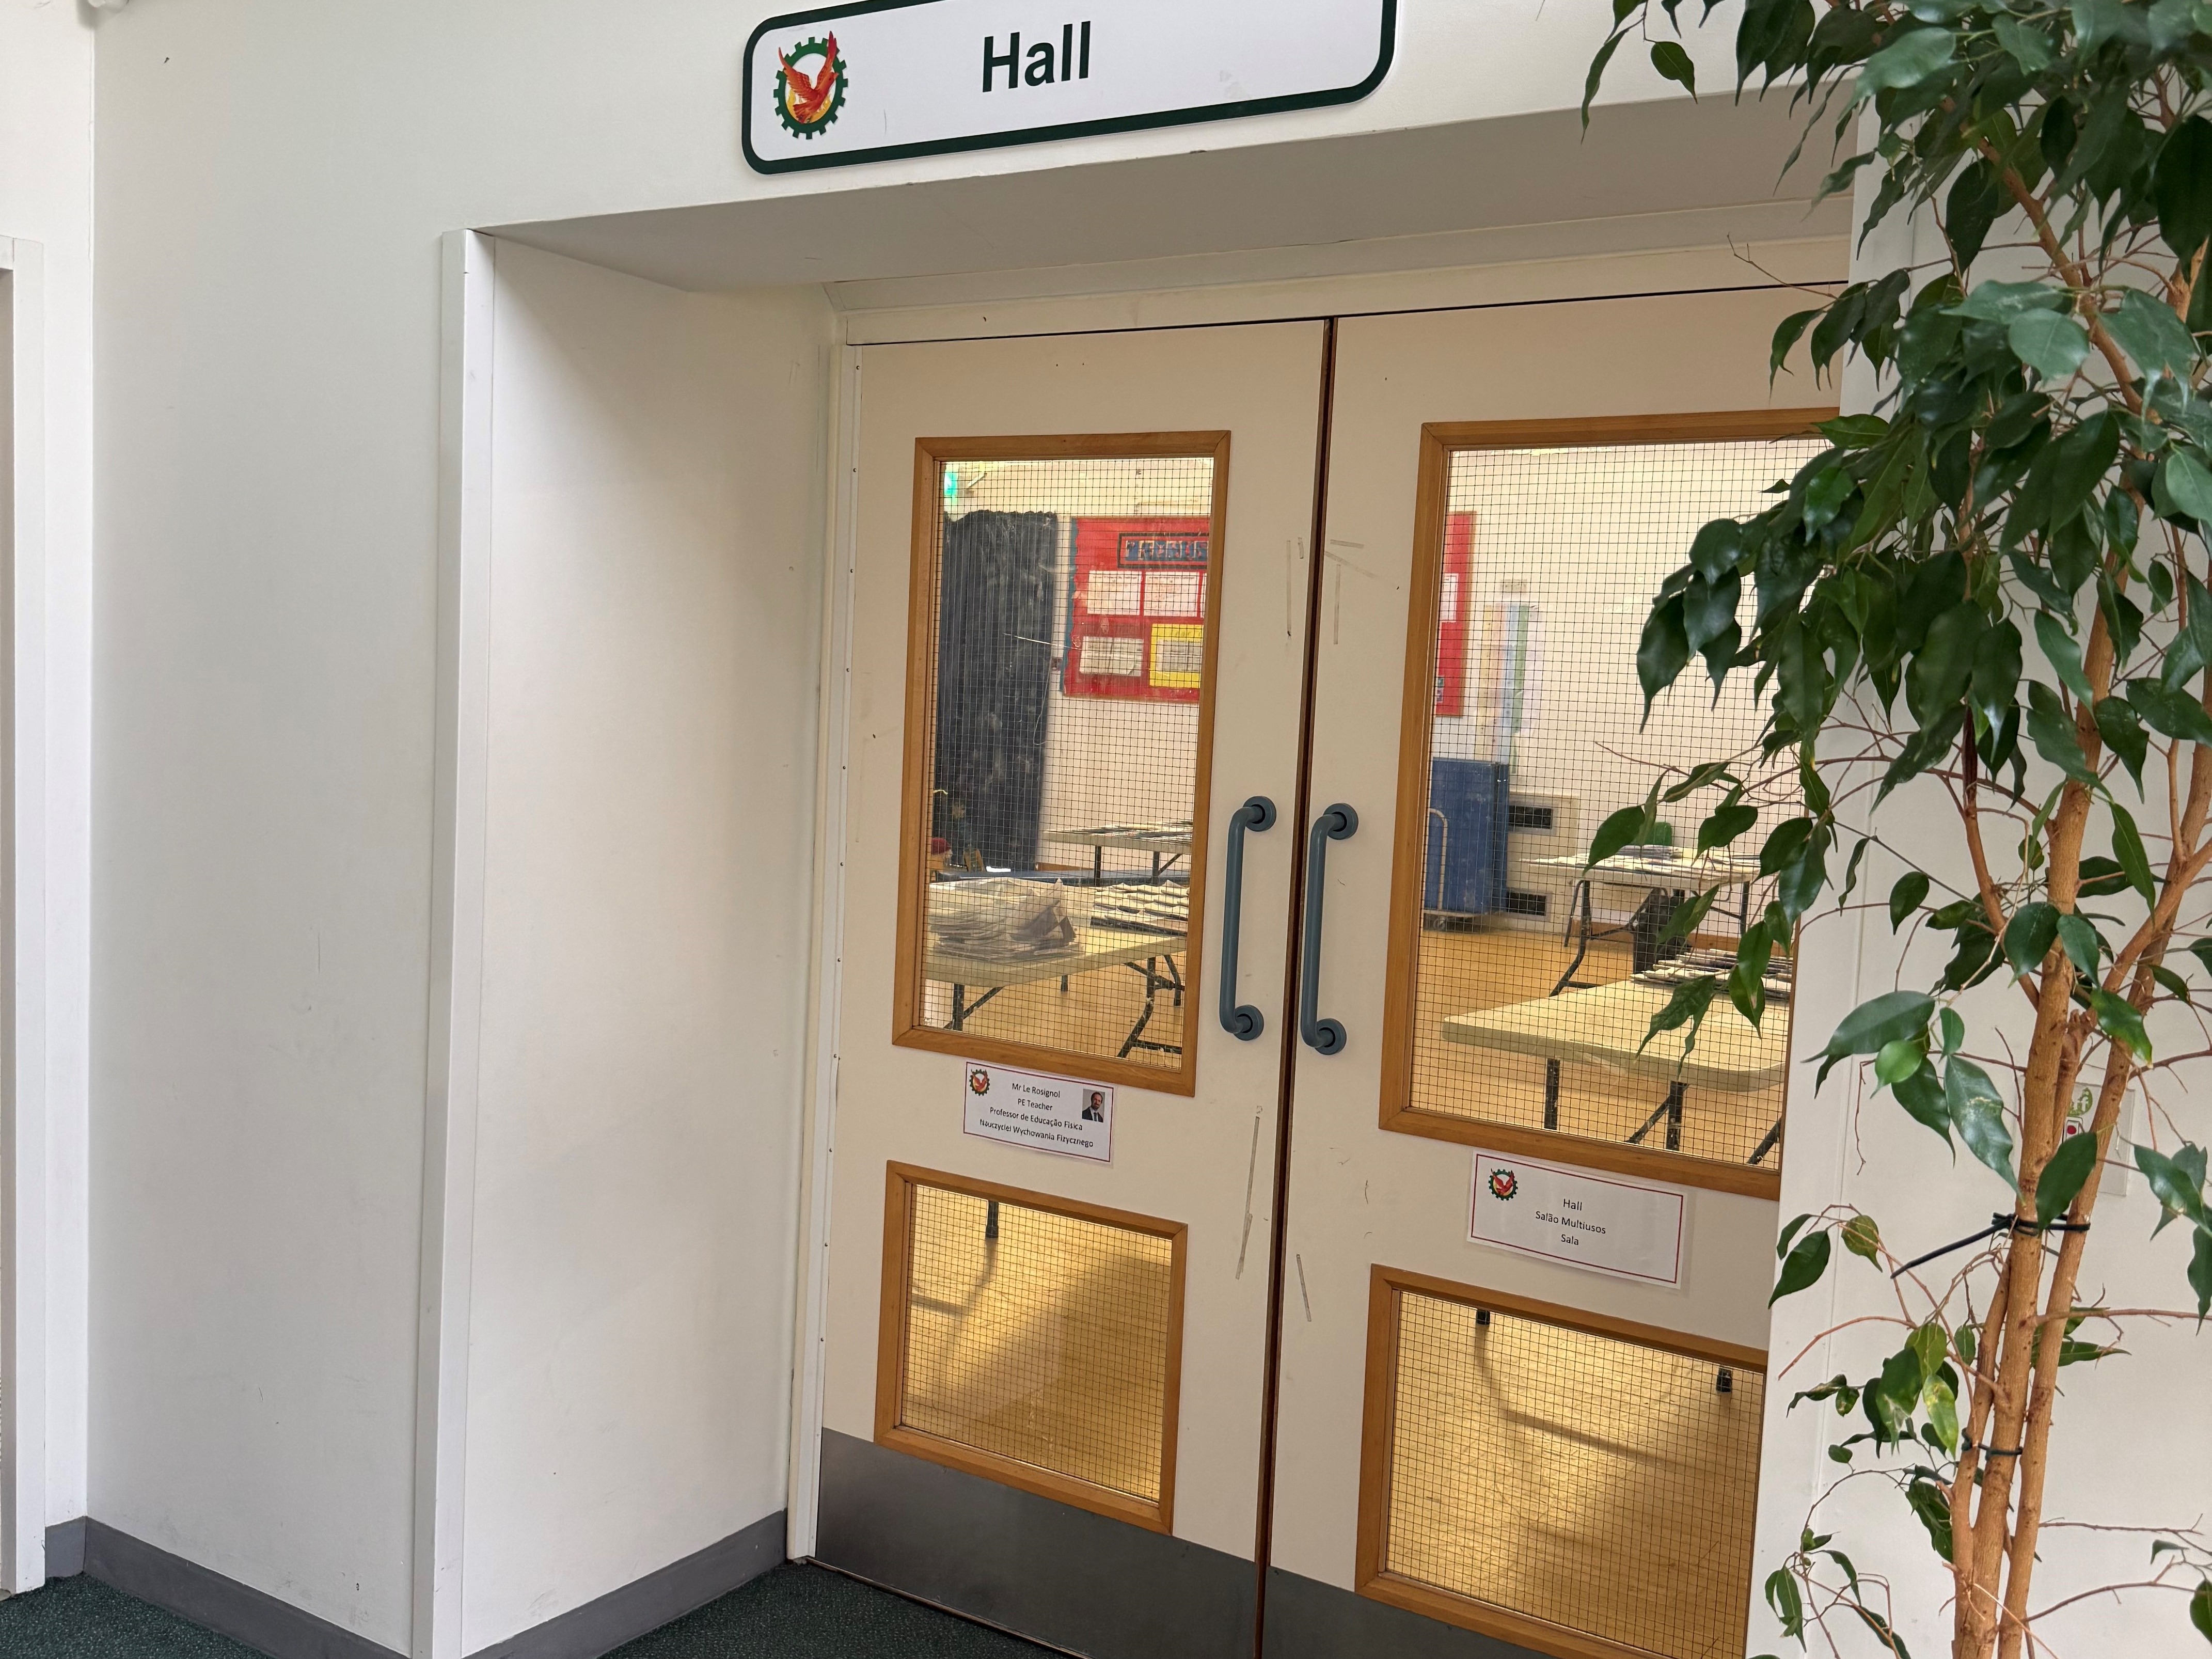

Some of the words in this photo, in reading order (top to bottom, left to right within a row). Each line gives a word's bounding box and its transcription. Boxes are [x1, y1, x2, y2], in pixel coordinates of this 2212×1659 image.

[982, 20, 1091, 93] Hall
[1012, 1083, 1022, 1091] Mr
[1023, 1084, 1031, 1093] Le
[1032, 1086, 1061, 1098] Rosignol
[1018, 1098, 1026, 1106] PE
[1027, 1100, 1053, 1111] Teacher
[990, 1107, 1019, 1119] Professor
[1020, 1113, 1029, 1121] de
[1030, 1115, 1062, 1127] Educação
[979, 1118, 1012, 1132] Nauczyciel
[1013, 1125, 1055, 1141] Wychowania
[1056, 1134, 1094, 1149] Fizycznego
[1563, 1198, 1582, 1211] Hall
[1535, 1211, 1559, 1224] Salão
[1561, 1216, 1606, 1234] Multiusos
[1561, 1234, 1579, 1245] Sala
